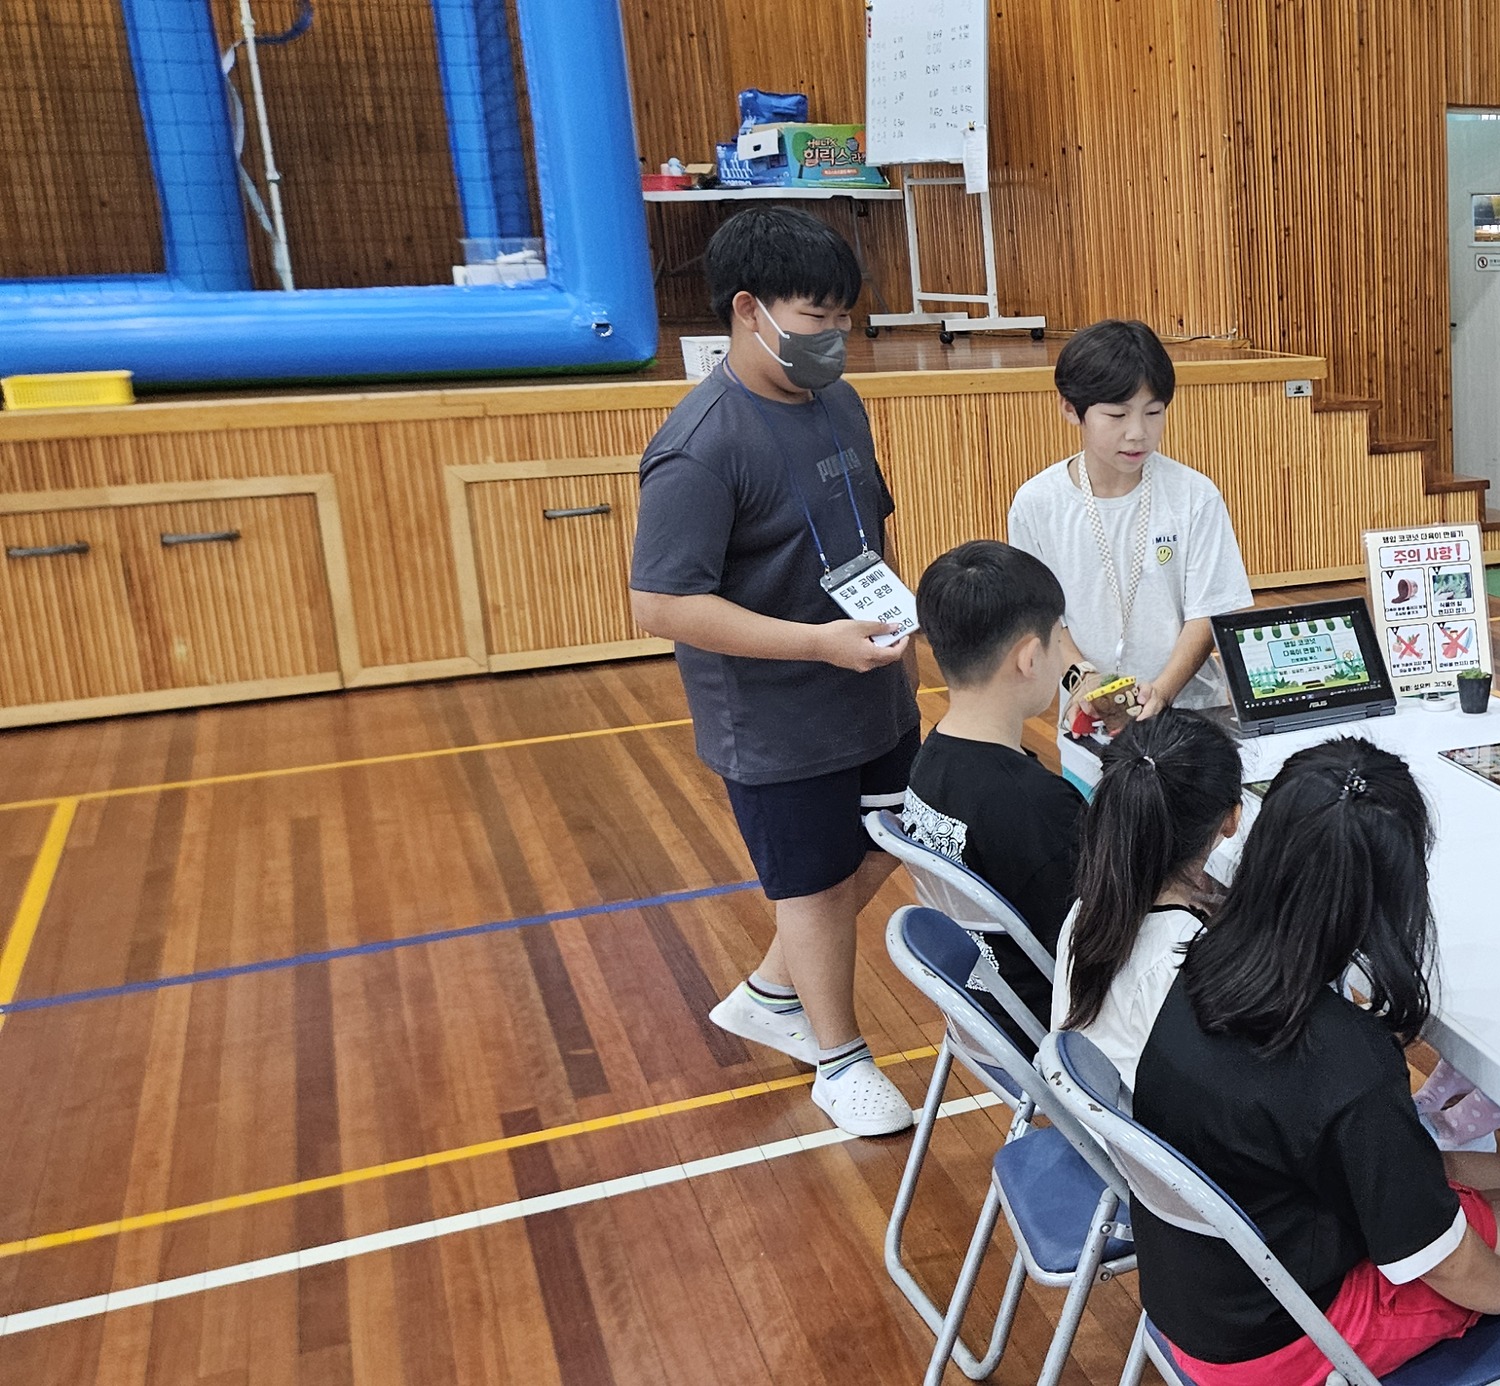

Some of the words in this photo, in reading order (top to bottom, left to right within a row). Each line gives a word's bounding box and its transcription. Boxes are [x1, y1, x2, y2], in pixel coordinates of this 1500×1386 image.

[804, 148, 850, 167] 힐릭스
[851, 152, 866, 165] 라
[1152, 534, 1177, 545] MILE
[1393, 549, 1421, 564] 주의
[839, 585, 858, 600] 토탈
[854, 596, 874, 610] 부스
[873, 584, 893, 599] 운영
[1308, 699, 1328, 709] ASUS
